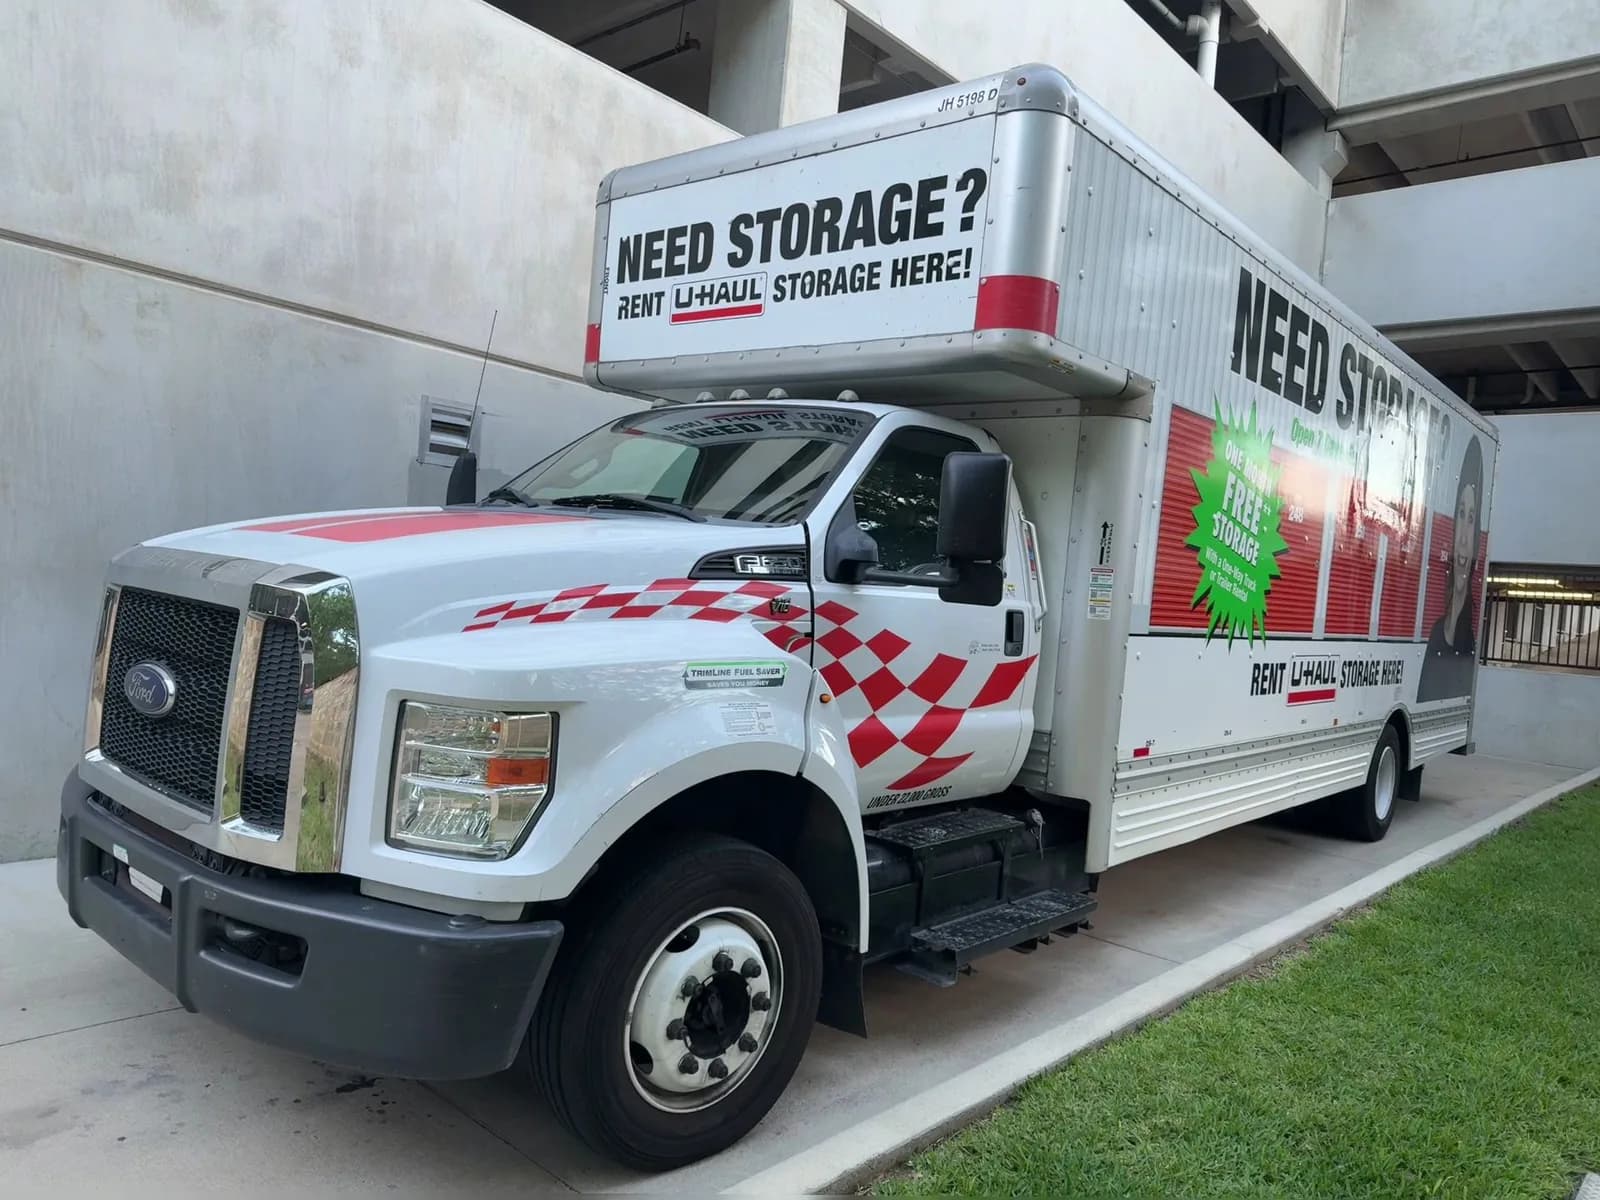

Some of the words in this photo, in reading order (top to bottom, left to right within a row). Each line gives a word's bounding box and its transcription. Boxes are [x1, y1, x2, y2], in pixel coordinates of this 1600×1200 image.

[938, 96, 955, 112] JH
[957, 90, 985, 108] 5198
[988, 88, 998, 101] D
[616, 221, 714, 285] NEED
[727, 167, 987, 268] STORAGE?
[618, 291, 665, 320] RENT
[673, 280, 763, 310] U-HAUL
[772, 260, 882, 303] STORAGE
[889, 247, 973, 288] HERE!
[1231, 266, 1330, 415] NEED
[1291, 417, 1315, 448] Open
[1225, 440, 1244, 471] ONE
[1212, 511, 1261, 567] STORAGE
[707, 681, 730, 689] SAVES
[730, 680, 746, 688] YOU
[746, 679, 771, 687] MONEY
[734, 668, 755, 676] FUEL
[756, 667, 781, 676] SAVER
[1250, 662, 1287, 697] RENT
[1290, 660, 1337, 687] U-HAUL
[1340, 660, 1381, 689] STORAGE
[1380, 660, 1405, 686] HERE!
[128, 671, 157, 705] Ford
[866, 793, 900, 809] UNDER
[922, 785, 953, 801] GROSS
